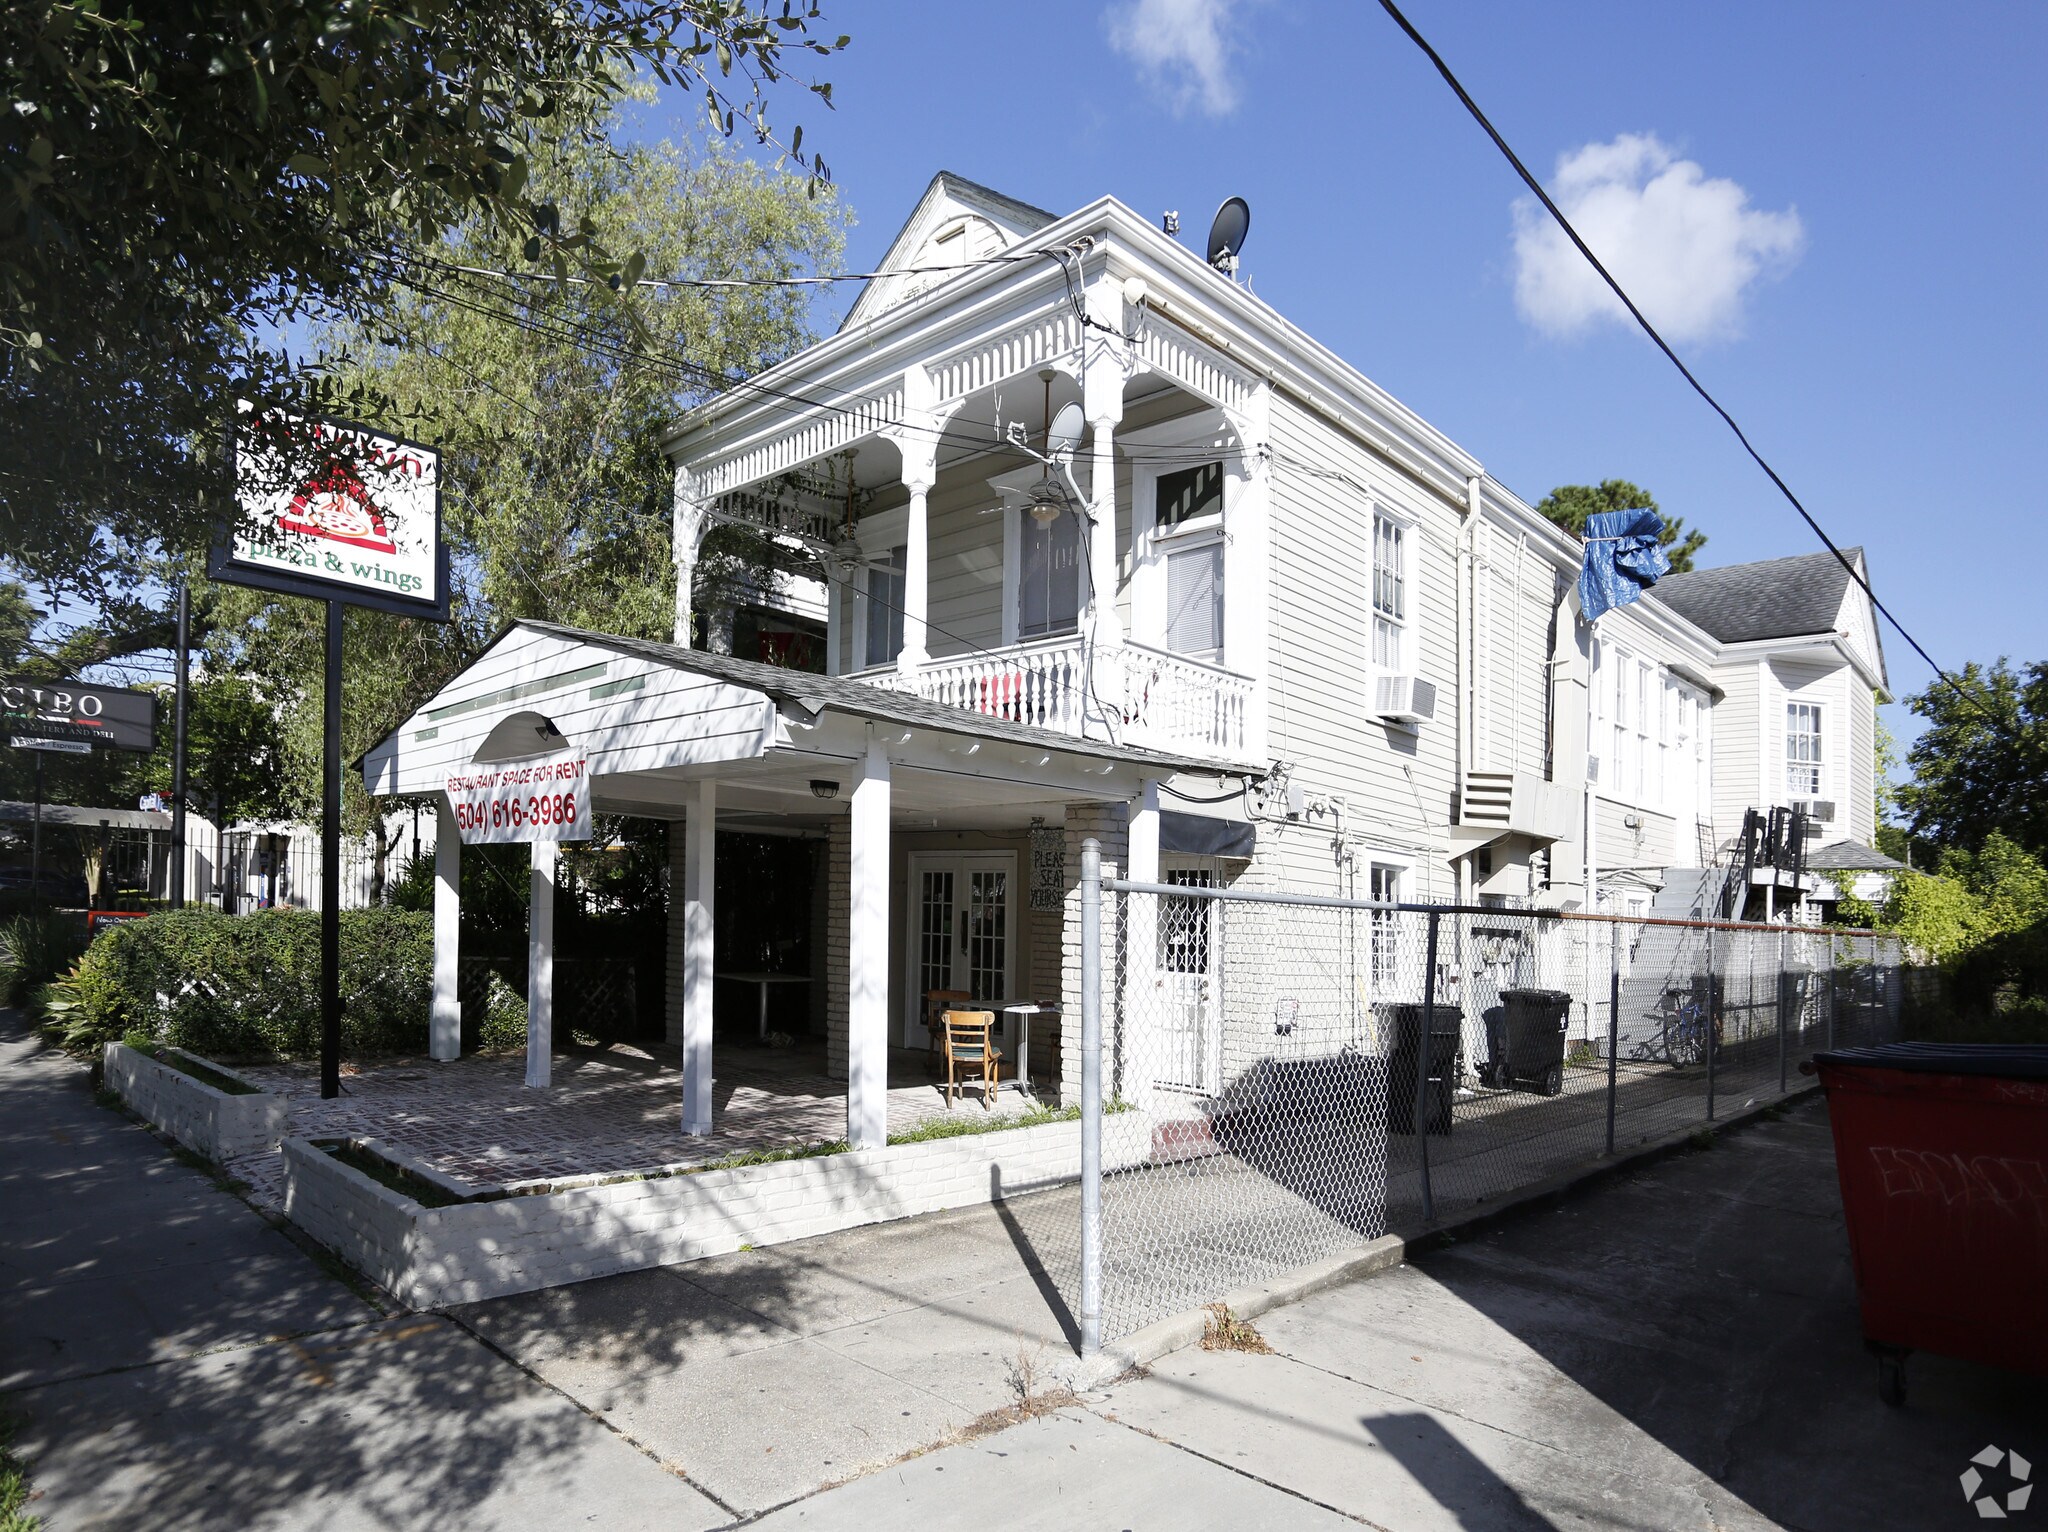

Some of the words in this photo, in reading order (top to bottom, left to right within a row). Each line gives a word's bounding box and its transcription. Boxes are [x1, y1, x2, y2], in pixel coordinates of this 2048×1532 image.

[248, 541, 318, 567] pizza
[325, 551, 344, 573] &
[350, 561, 422, 592] wings
[0, 686, 103, 717] CIBO
[69, 727, 90, 736] AND
[53, 740, 84, 751] Espresso
[447, 772, 501, 793] RESTAURANT
[501, 768, 532, 787] SPACE
[533, 765, 553, 783] FOR
[555, 760, 586, 780] RENT
[455, 800, 488, 835] (504)
[492, 792, 577, 828] 616-3986
[1034, 850, 1066, 868] PLEAS
[1040, 869, 1064, 888] SEAT
